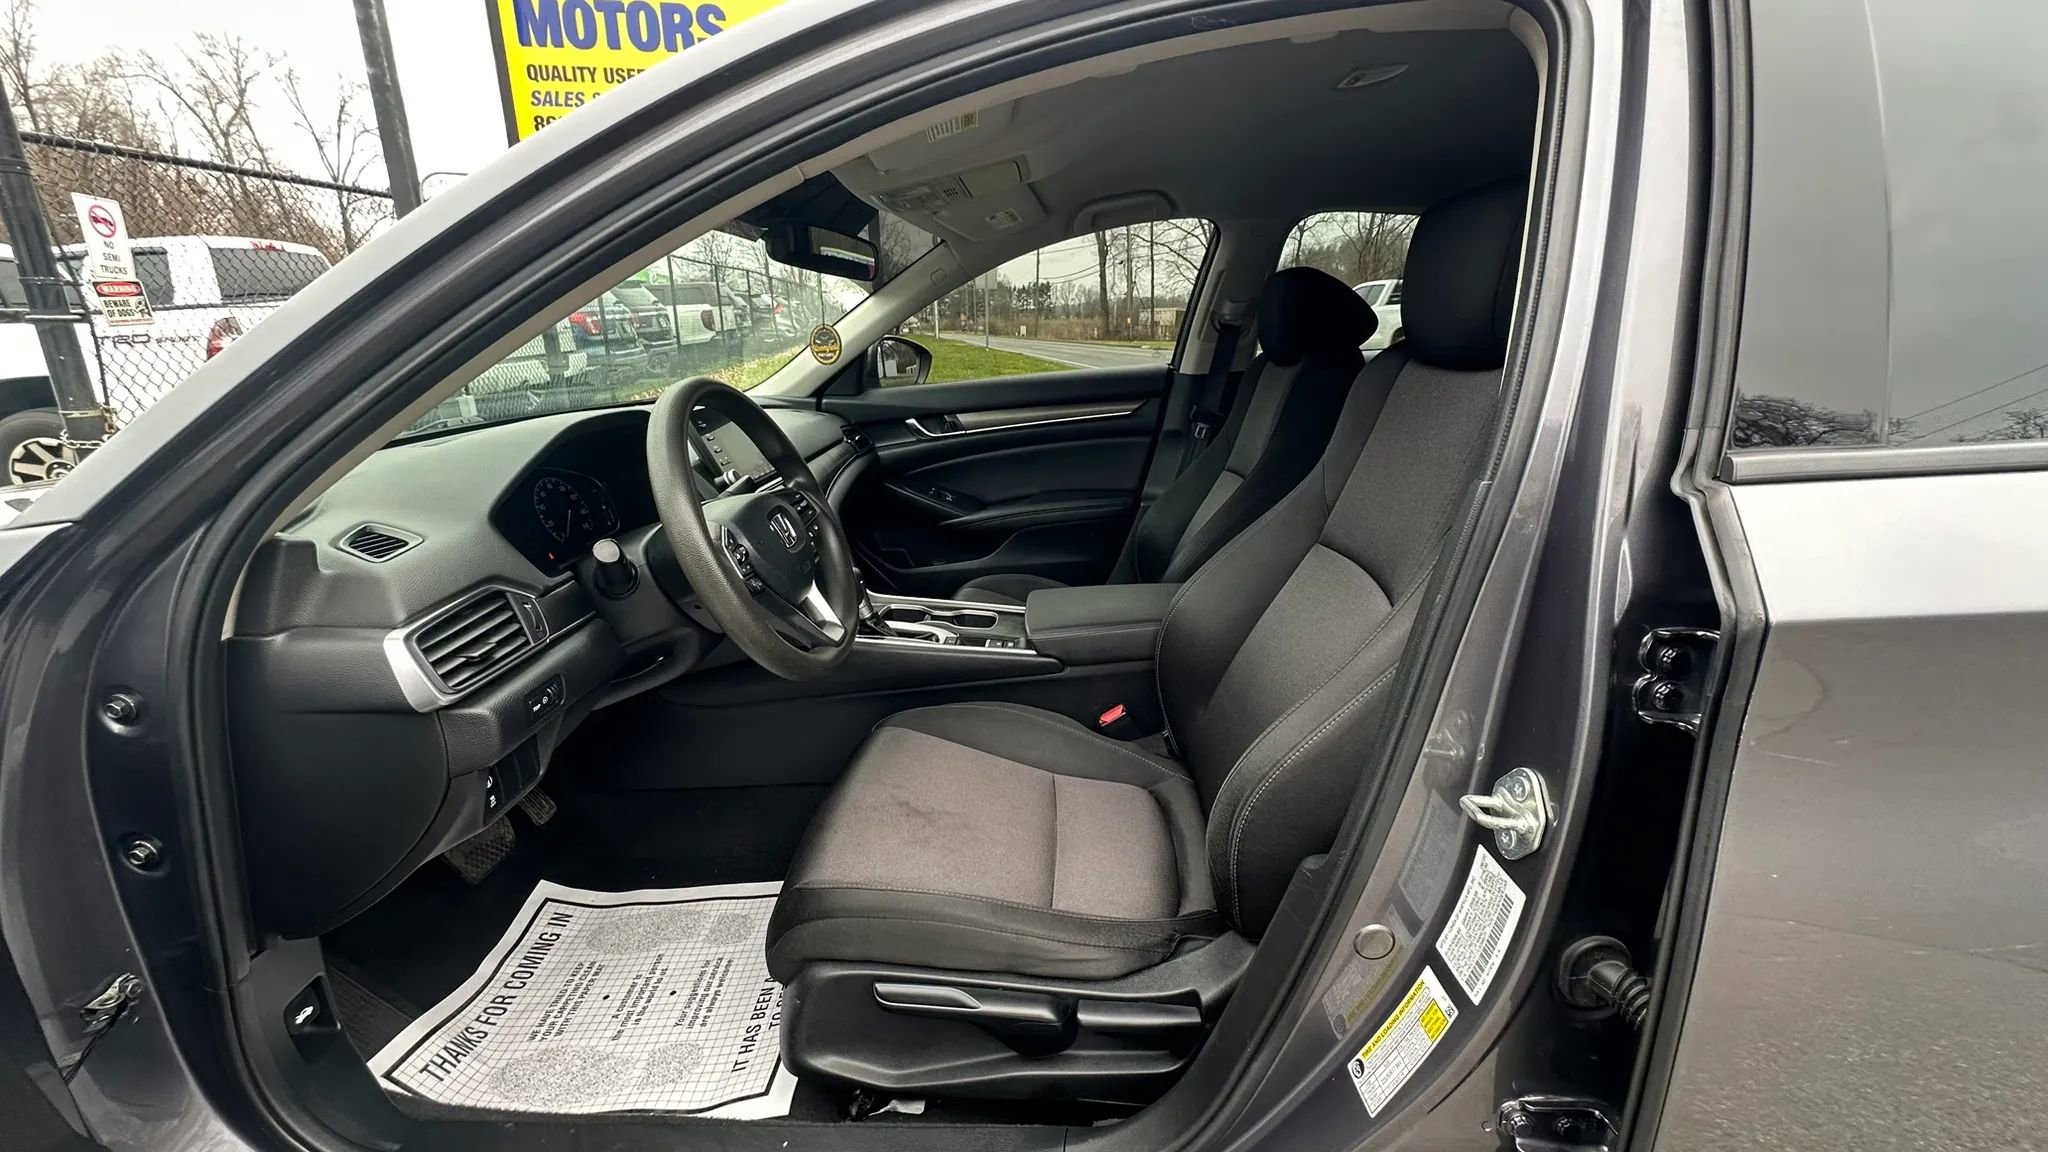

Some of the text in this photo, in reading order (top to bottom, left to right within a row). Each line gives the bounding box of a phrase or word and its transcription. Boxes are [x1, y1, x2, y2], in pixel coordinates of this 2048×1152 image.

[513, 0, 726, 52] MOTORS
[526, 64, 645, 84] QUALITY USE
[531, 90, 585, 108] SALES
[103, 253, 120, 262] SEMI
[104, 241, 114, 250] NO
[100, 264, 128, 275] TRUCKS
[103, 299, 131, 308] BEWARE
[107, 309, 135, 317] OF DOGS
[419, 912, 573, 1082] THANKS FOR COMING IN
[539, 1020, 559, 1041] YOUR
[554, 982, 583, 1019] CARPETING
[553, 1018, 573, 1037] WITH
[567, 1000, 584, 1015] THIS
[578, 978, 598, 999] PAPER
[611, 1029, 624, 1041] the
[620, 1010, 635, 1027] most
[631, 976, 654, 1008] important
[616, 982, 638, 1012] customer
[636, 1005, 648, 1016] the
[645, 985, 659, 1004] world
[686, 993, 709, 1029] improving
[704, 981, 713, 992] our
[700, 1015, 710, 1027] are
[706, 989, 721, 1013] always
[750, 986, 775, 1021] BEEN
[527, 1029, 541, 1041] WE
[536, 1009, 555, 1027] HAVE
[673, 1010, 688, 1027] Your
[1372, 1035, 1382, 1048] AND
[1381, 1015, 1400, 1038] LOADING
[738, 1024, 761, 1055] HAS
[731, 1060, 749, 1072] IT
